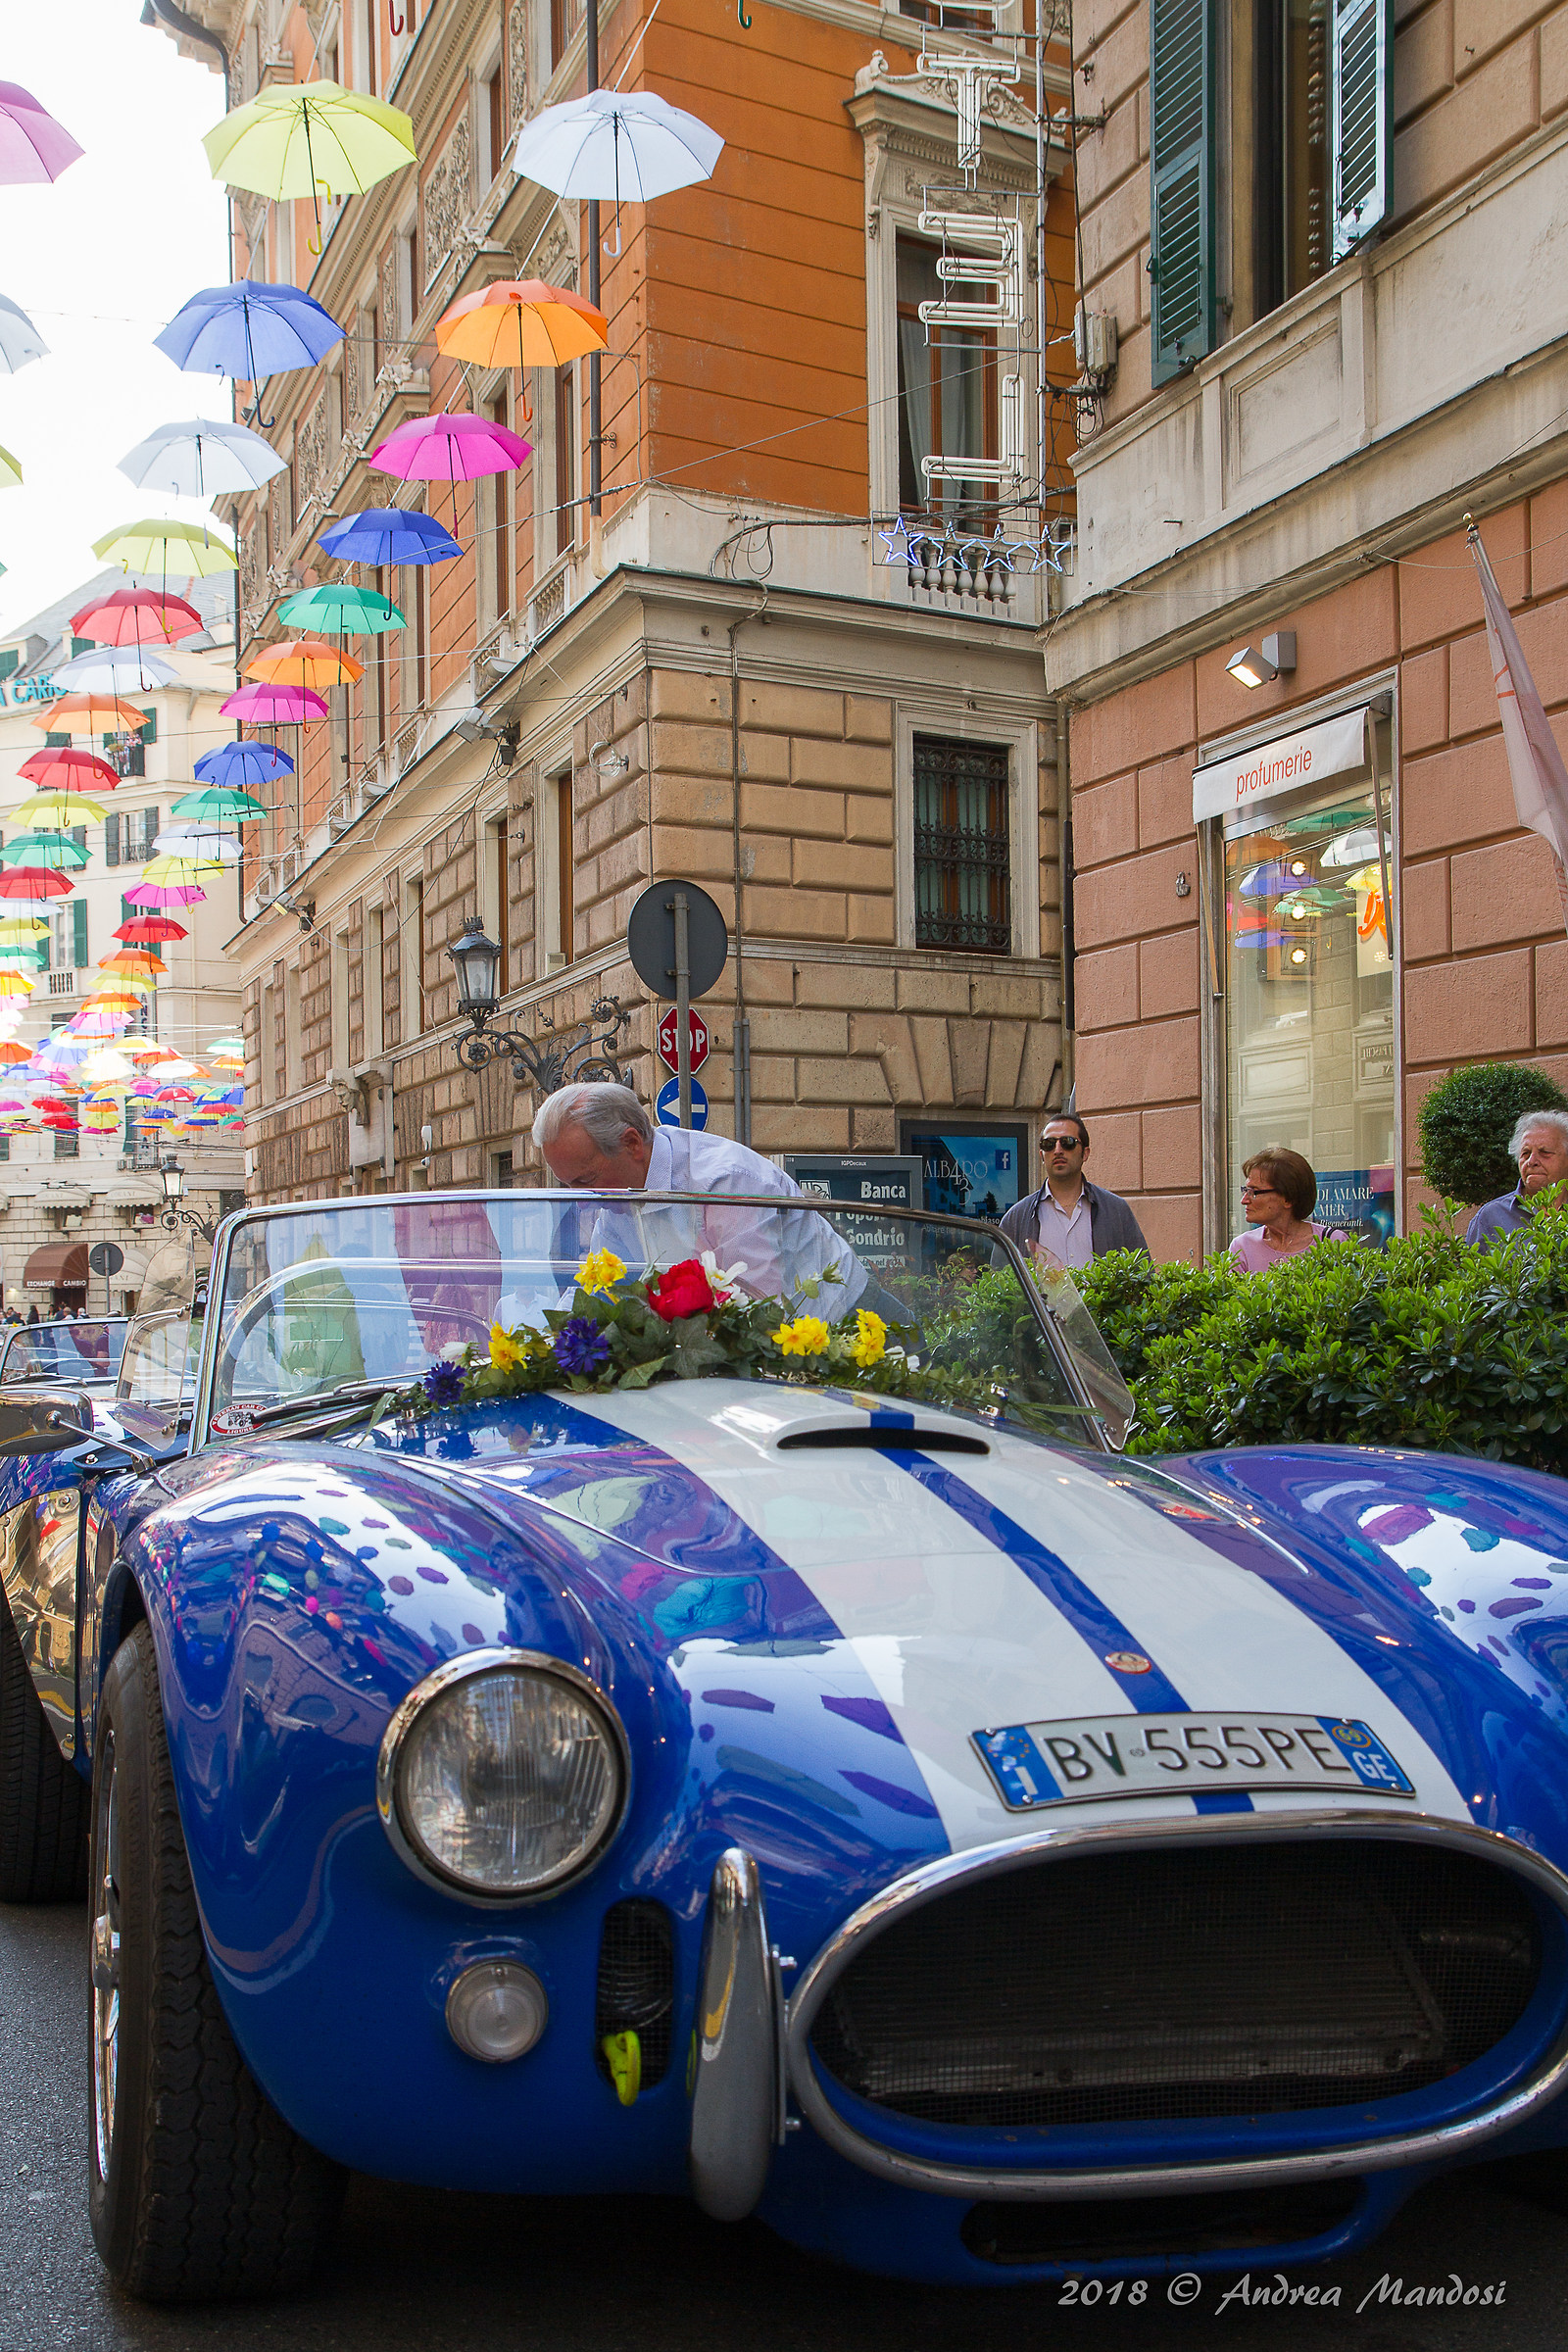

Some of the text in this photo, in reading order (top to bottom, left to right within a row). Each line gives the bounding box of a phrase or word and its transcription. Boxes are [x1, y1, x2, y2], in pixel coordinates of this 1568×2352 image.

[1236, 746, 1312, 802] profumerie
[860, 1181, 906, 1199] Banca
[1317, 1186, 1375, 1201] DI AMARE
[1319, 1203, 1346, 1217] MER
[1043, 1731, 1126, 1783] BV
[1143, 1727, 1351, 1773] 555PE
[1352, 1750, 1397, 1782] GE
